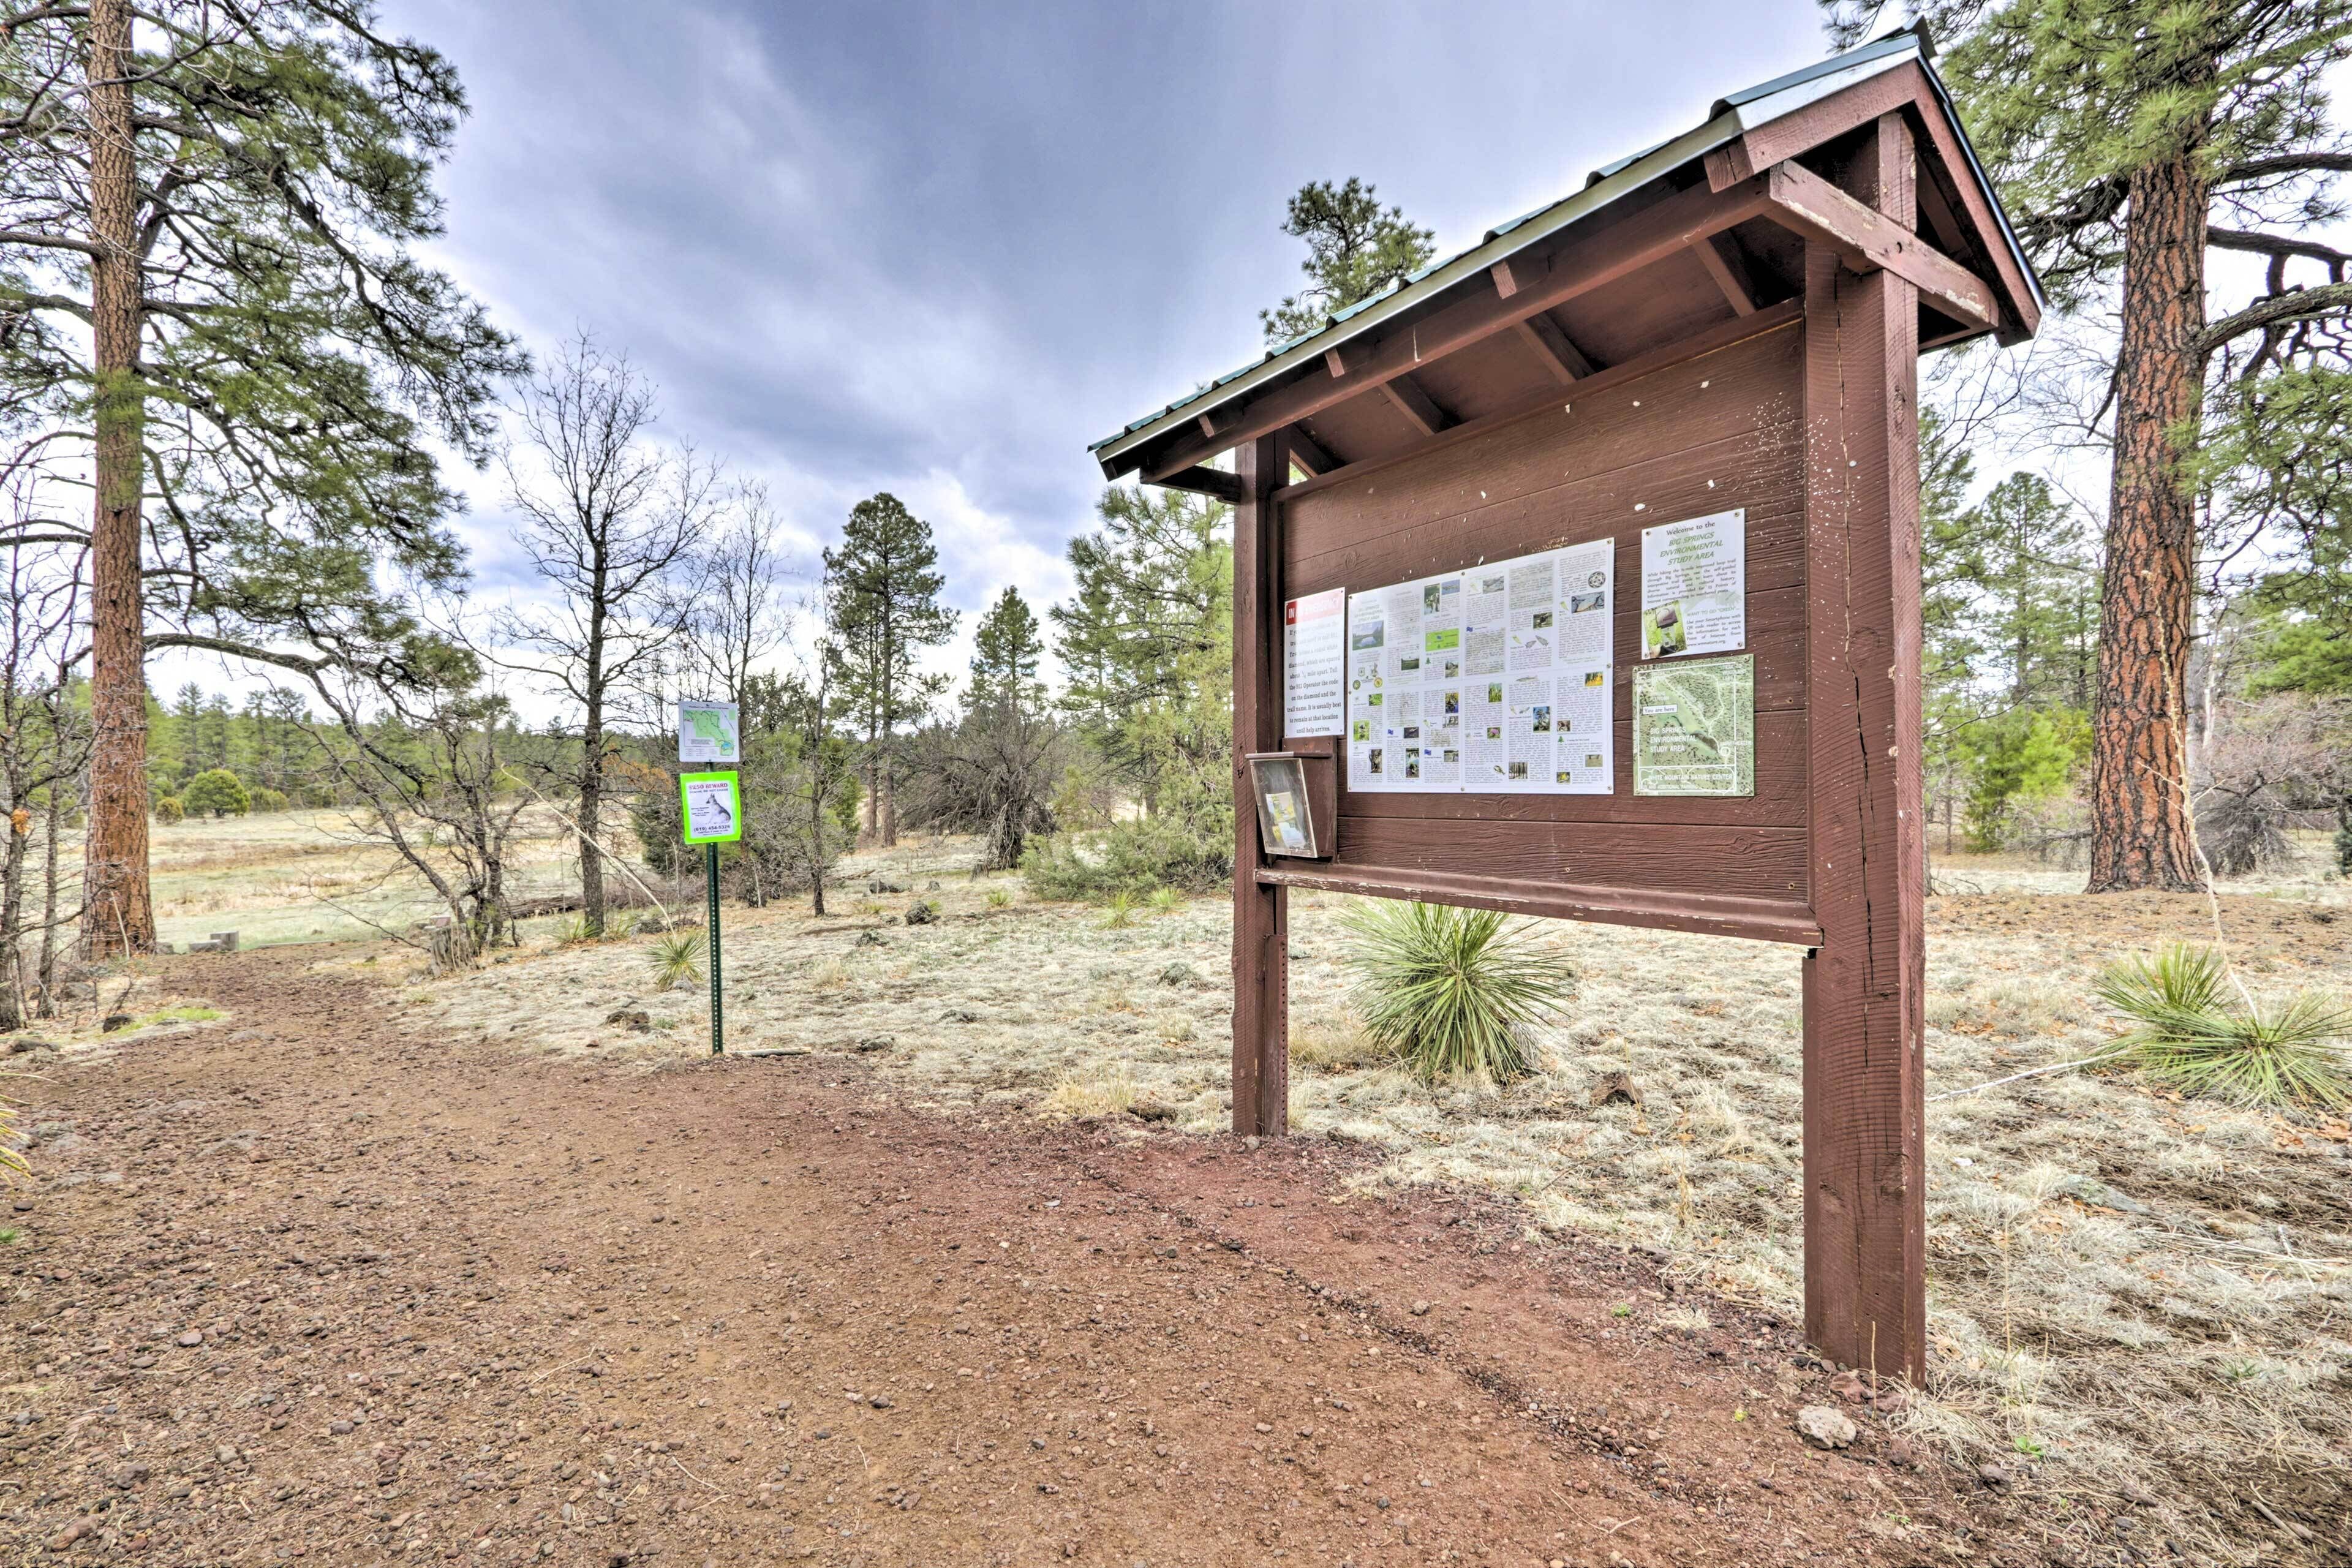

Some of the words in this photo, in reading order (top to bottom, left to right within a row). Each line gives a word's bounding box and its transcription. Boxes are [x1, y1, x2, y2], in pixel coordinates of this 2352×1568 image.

[1667, 527, 1694, 535] Welcome
[1683, 532, 1715, 544] SPRINGS
[1660, 540, 1724, 557] ENVIRONMENTAL
[1668, 555, 1693, 565] STUDY
[1695, 551, 1714, 560] AREA
[1289, 608, 1295, 619] IN
[1303, 681, 1321, 690] Operator
[1650, 735, 1697, 744] ENVIRONMENTAL
